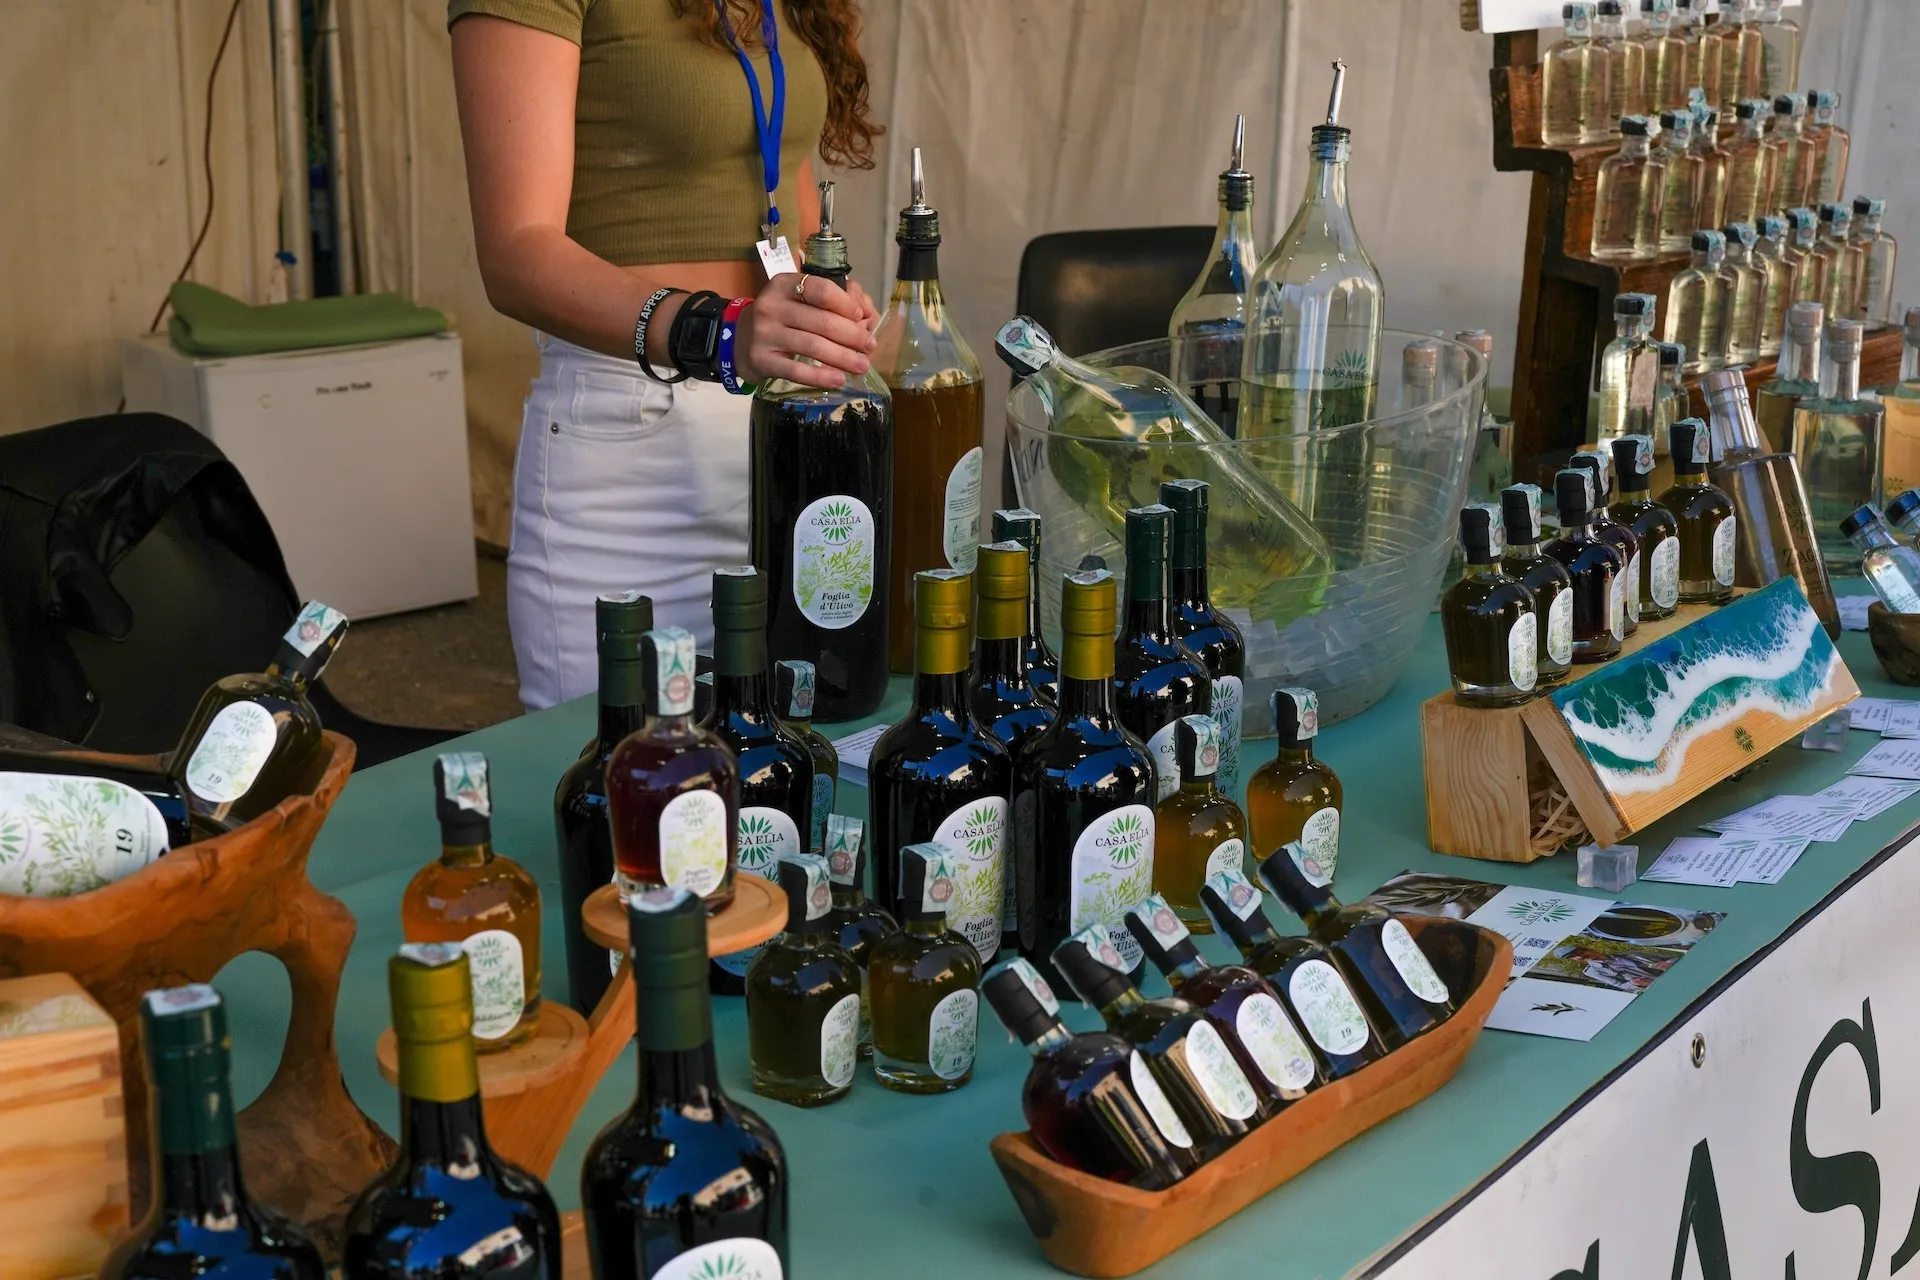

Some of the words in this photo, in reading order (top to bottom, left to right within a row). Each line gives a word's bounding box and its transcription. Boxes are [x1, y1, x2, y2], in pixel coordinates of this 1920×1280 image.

[634, 321, 646, 355] SOGNI
[641, 288, 671, 320] APPESI
[721, 361, 736, 389] LOVE
[1323, 367, 1353, 379] CASA
[811, 517, 838, 526] CASA
[839, 516, 861, 525] ELIA
[821, 592, 850, 602] Foglia
[820, 602, 854, 611] d'Ulivo
[1211, 702, 1222, 711] SA
[1160, 744, 1176, 754] CA
[208, 772, 223, 784] 19
[953, 827, 985, 840] CASA
[986, 819, 1006, 834] ELIA
[116, 828, 134, 855] 19
[738, 835, 753, 846] SA
[756, 832, 785, 845] ELIA
[1095, 834, 1128, 848] CASA
[1128, 827, 1150, 843] ELIA
[964, 917, 993, 933] Foglia
[1113, 939, 1140, 952] 'Ulivo
[942, 1004, 960, 1014] CASA
[1340, 1027, 1352, 1039] 19
[951, 1055, 963, 1067] 19
